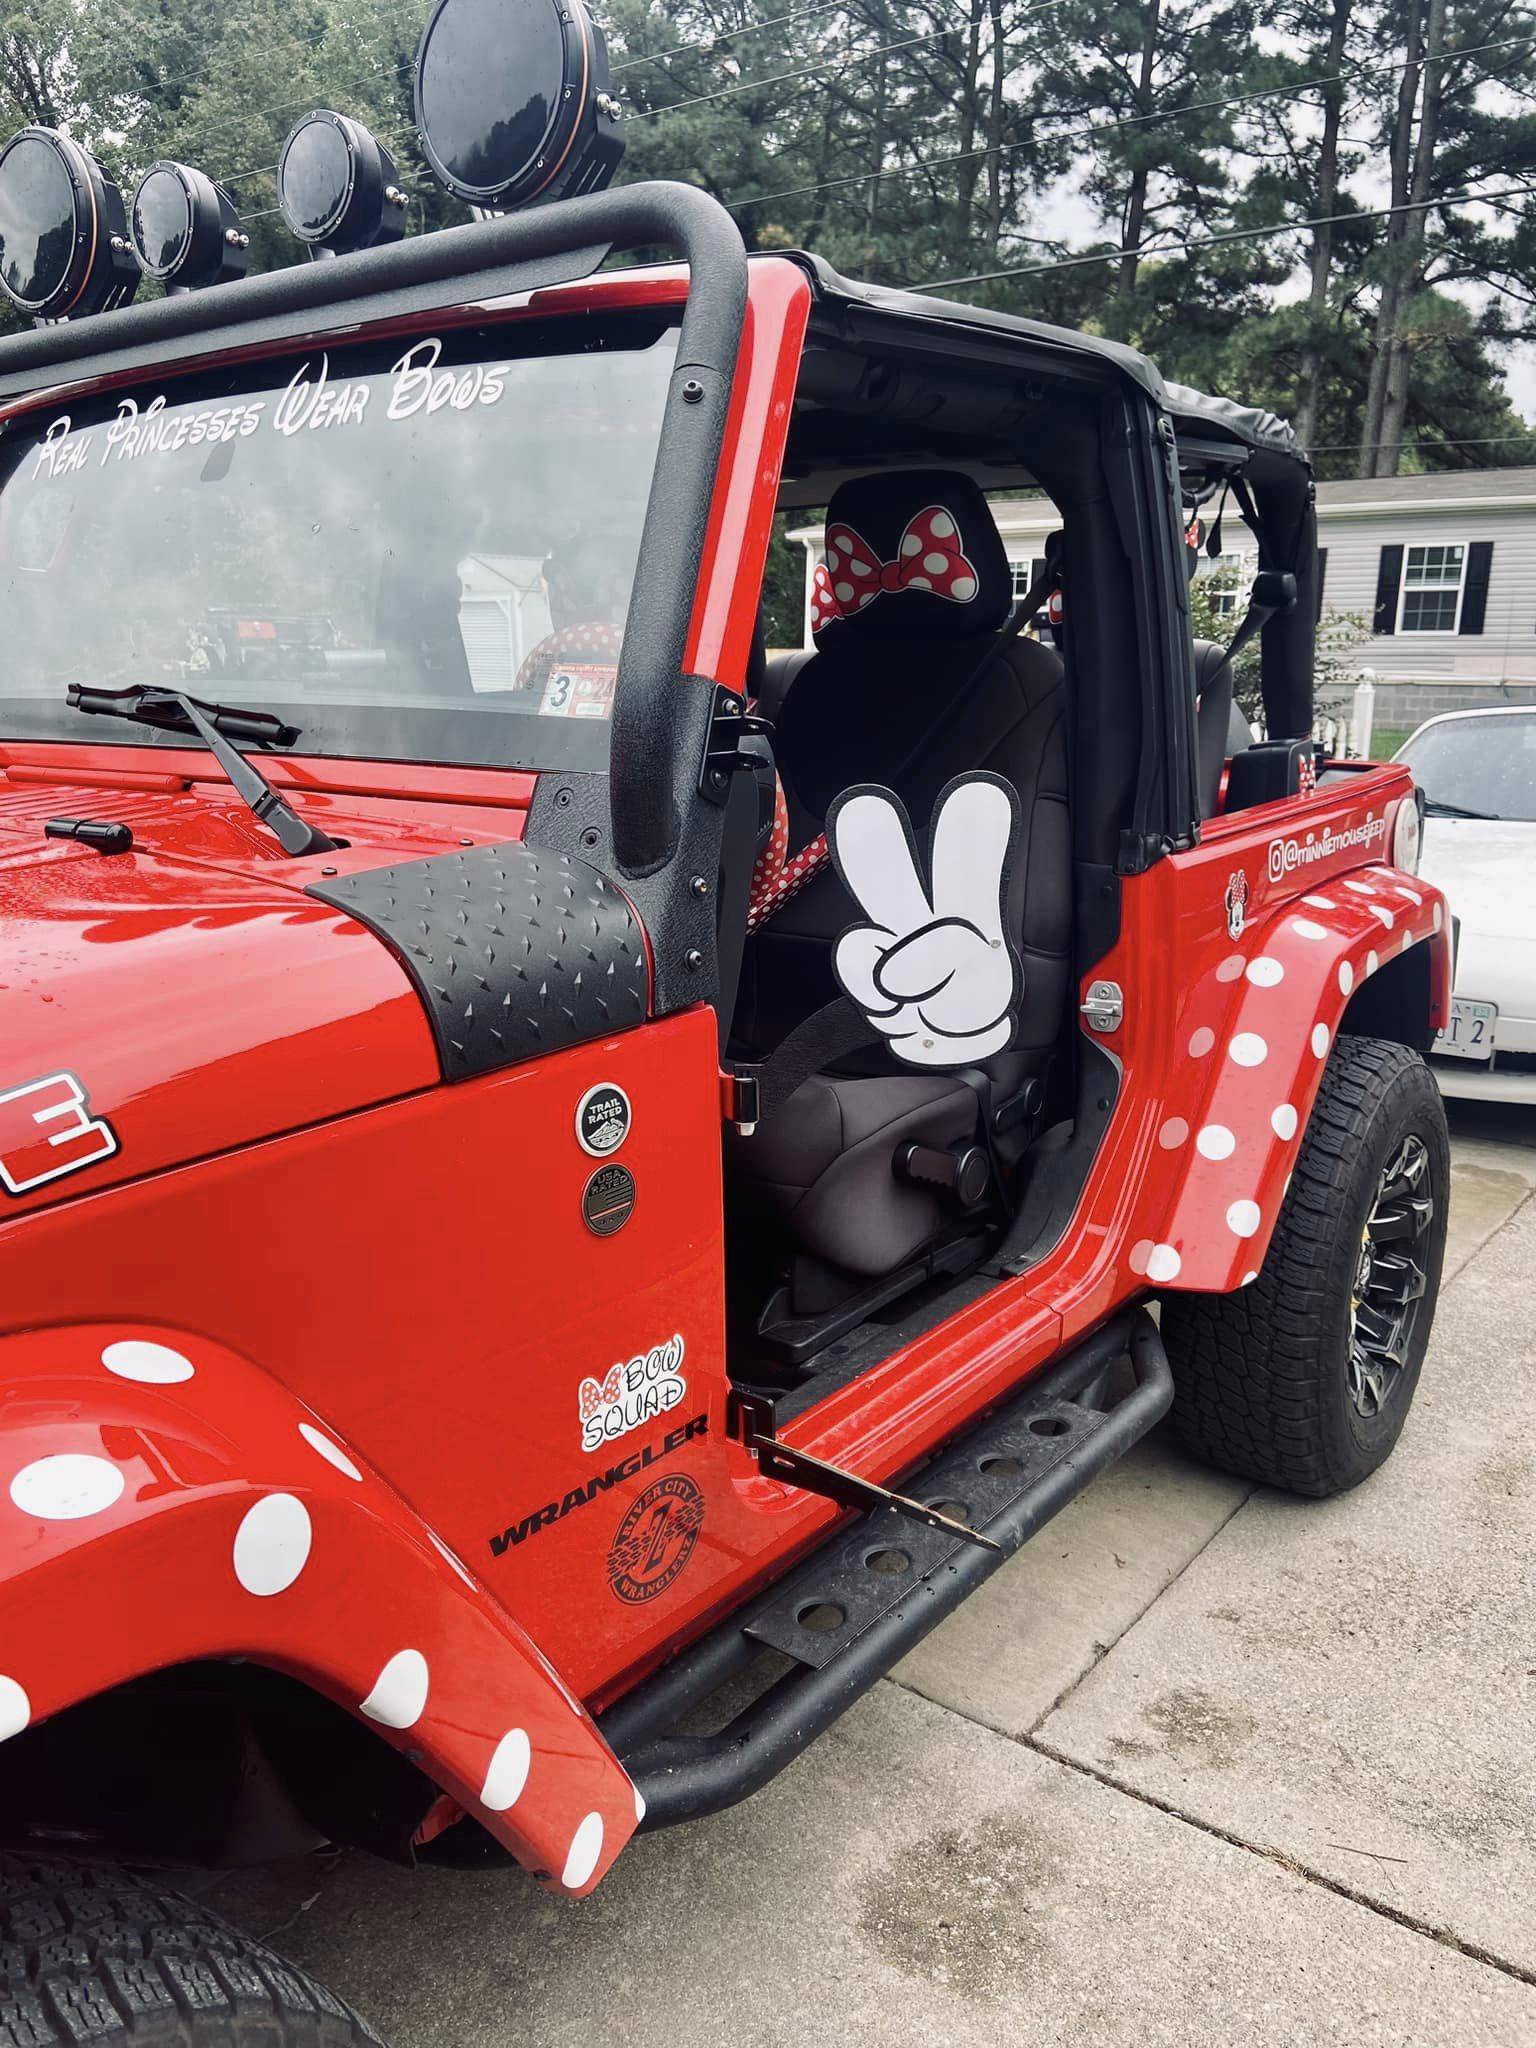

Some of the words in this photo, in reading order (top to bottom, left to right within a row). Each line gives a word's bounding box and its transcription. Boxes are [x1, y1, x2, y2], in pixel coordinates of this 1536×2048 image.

[550, 676, 570, 707] 3
[1470, 1020, 1485, 1044] 2
[588, 1106, 623, 1125] RATED
[589, 1098, 621, 1114] TRAIL
[591, 1175, 629, 1195] RATED
[597, 1169, 622, 1185] USA
[622, 1337, 682, 1392] BOW
[584, 1378, 684, 1448] SQUAD
[489, 1414, 709, 1557] WRANGLER
[620, 1486, 662, 1537] RIVER
[664, 1480, 693, 1499] CITY
